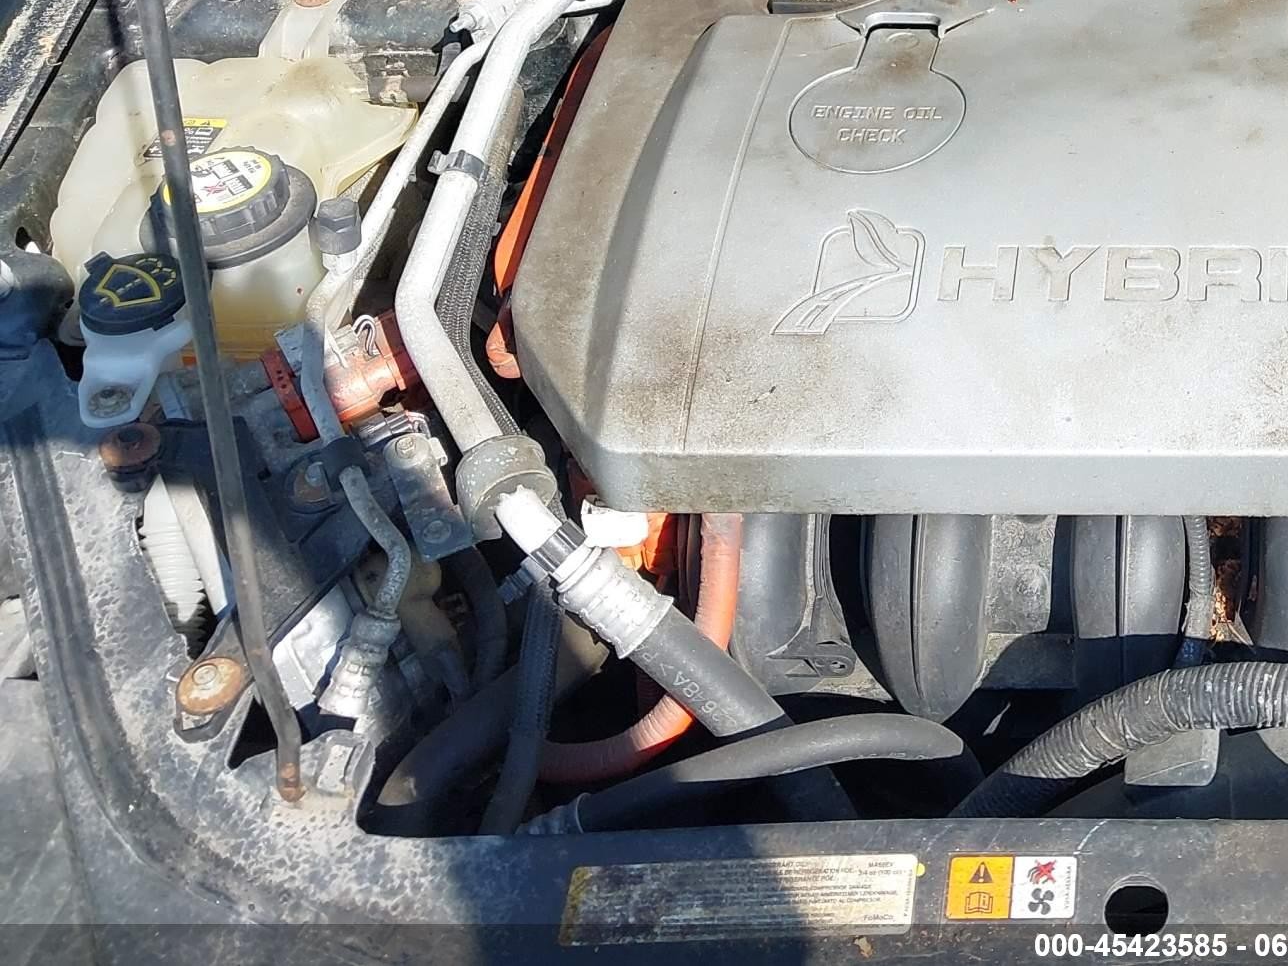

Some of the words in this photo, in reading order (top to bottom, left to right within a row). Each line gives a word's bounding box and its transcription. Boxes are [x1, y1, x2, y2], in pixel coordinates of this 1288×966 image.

[812, 105, 896, 119] ENGINE
[903, 106, 943, 120] OIL
[837, 128, 906, 143] CHECK
